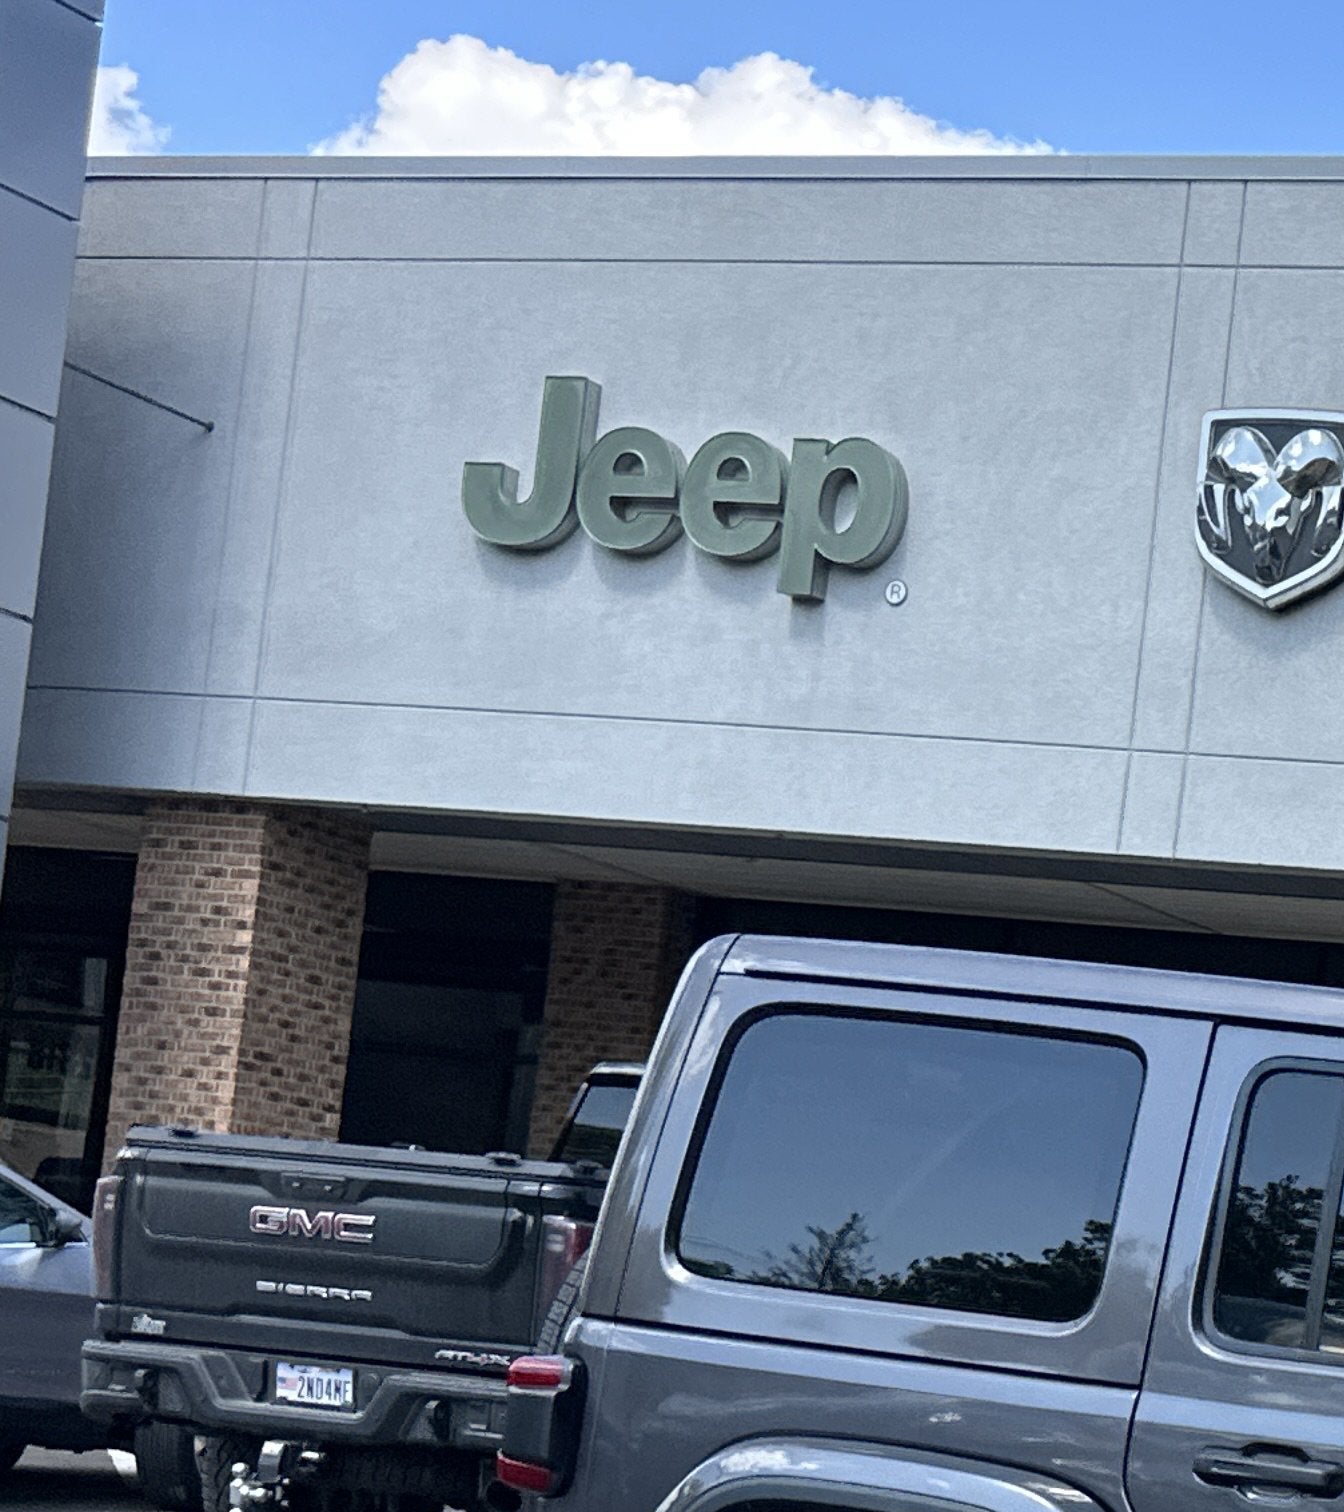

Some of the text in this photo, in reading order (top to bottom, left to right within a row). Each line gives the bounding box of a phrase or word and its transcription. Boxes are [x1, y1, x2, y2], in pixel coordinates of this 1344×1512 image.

[461, 375, 909, 603] Jeep
[249, 1205, 376, 1243] GMC
[255, 1280, 372, 1301] SIERRA
